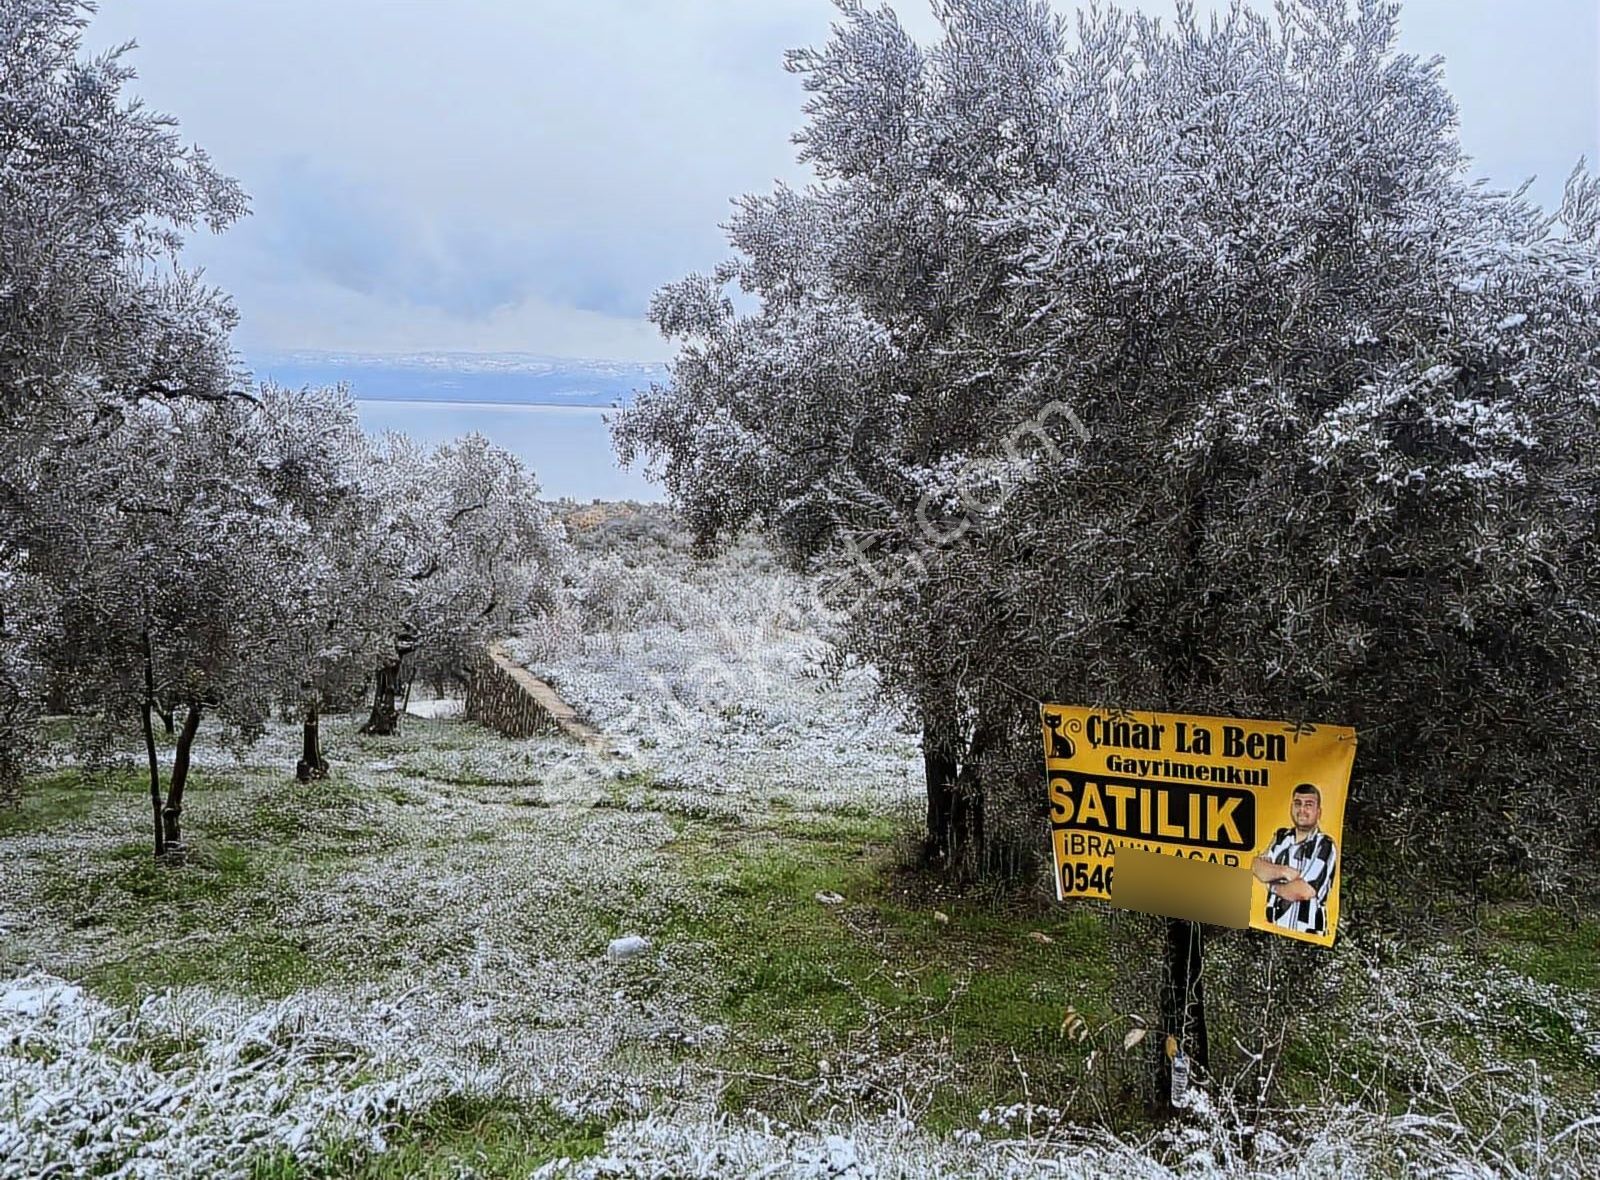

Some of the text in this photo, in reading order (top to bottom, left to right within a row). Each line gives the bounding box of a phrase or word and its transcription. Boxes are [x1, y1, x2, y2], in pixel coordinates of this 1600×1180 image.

[1175, 721, 1212, 756] La
[1222, 725, 1287, 763] Ben
[1106, 754, 1269, 787] Gayrimenkul
[1050, 777, 1244, 845] SATILIK
